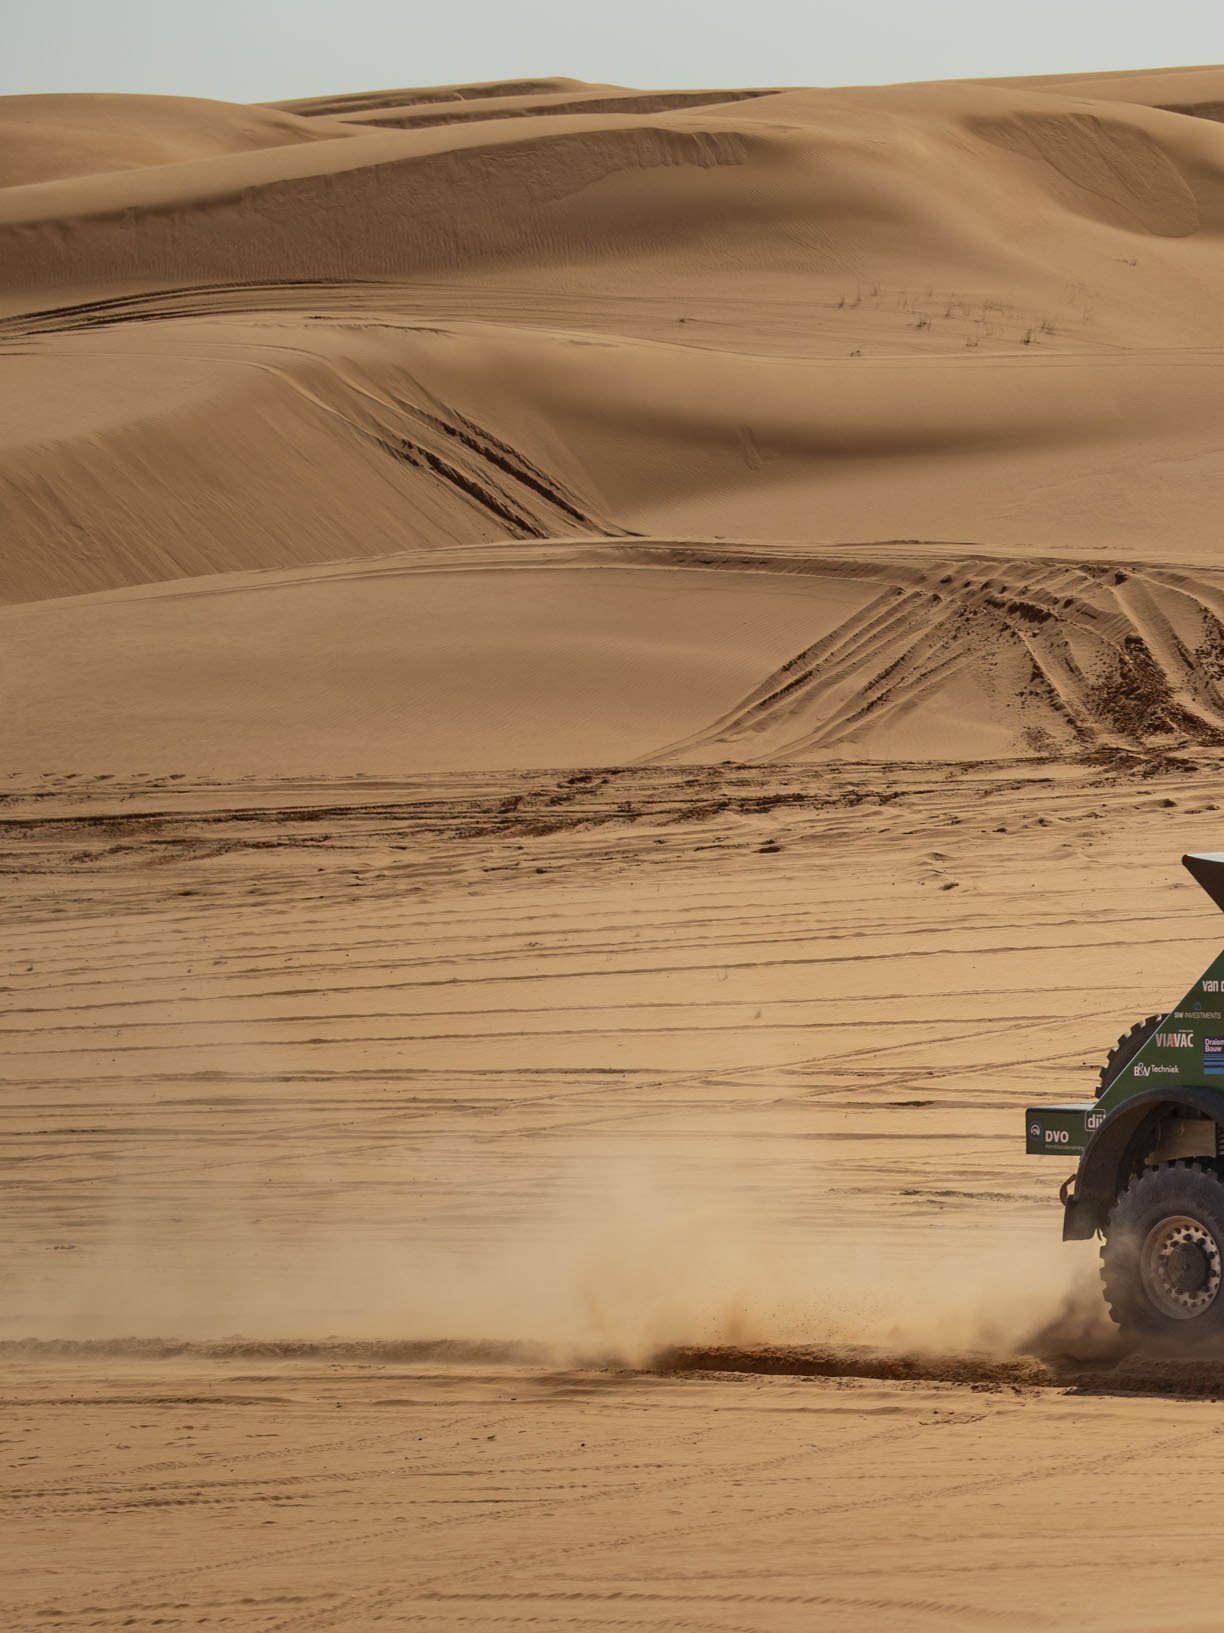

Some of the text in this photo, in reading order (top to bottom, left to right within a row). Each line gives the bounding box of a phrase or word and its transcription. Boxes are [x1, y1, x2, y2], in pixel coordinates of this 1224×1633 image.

[1202, 980, 1217, 992] van
[1156, 1033, 1194, 1047] VIAVAC
[1151, 1065, 1179, 1073] Techniek
[1045, 1131, 1069, 1143] DVO
